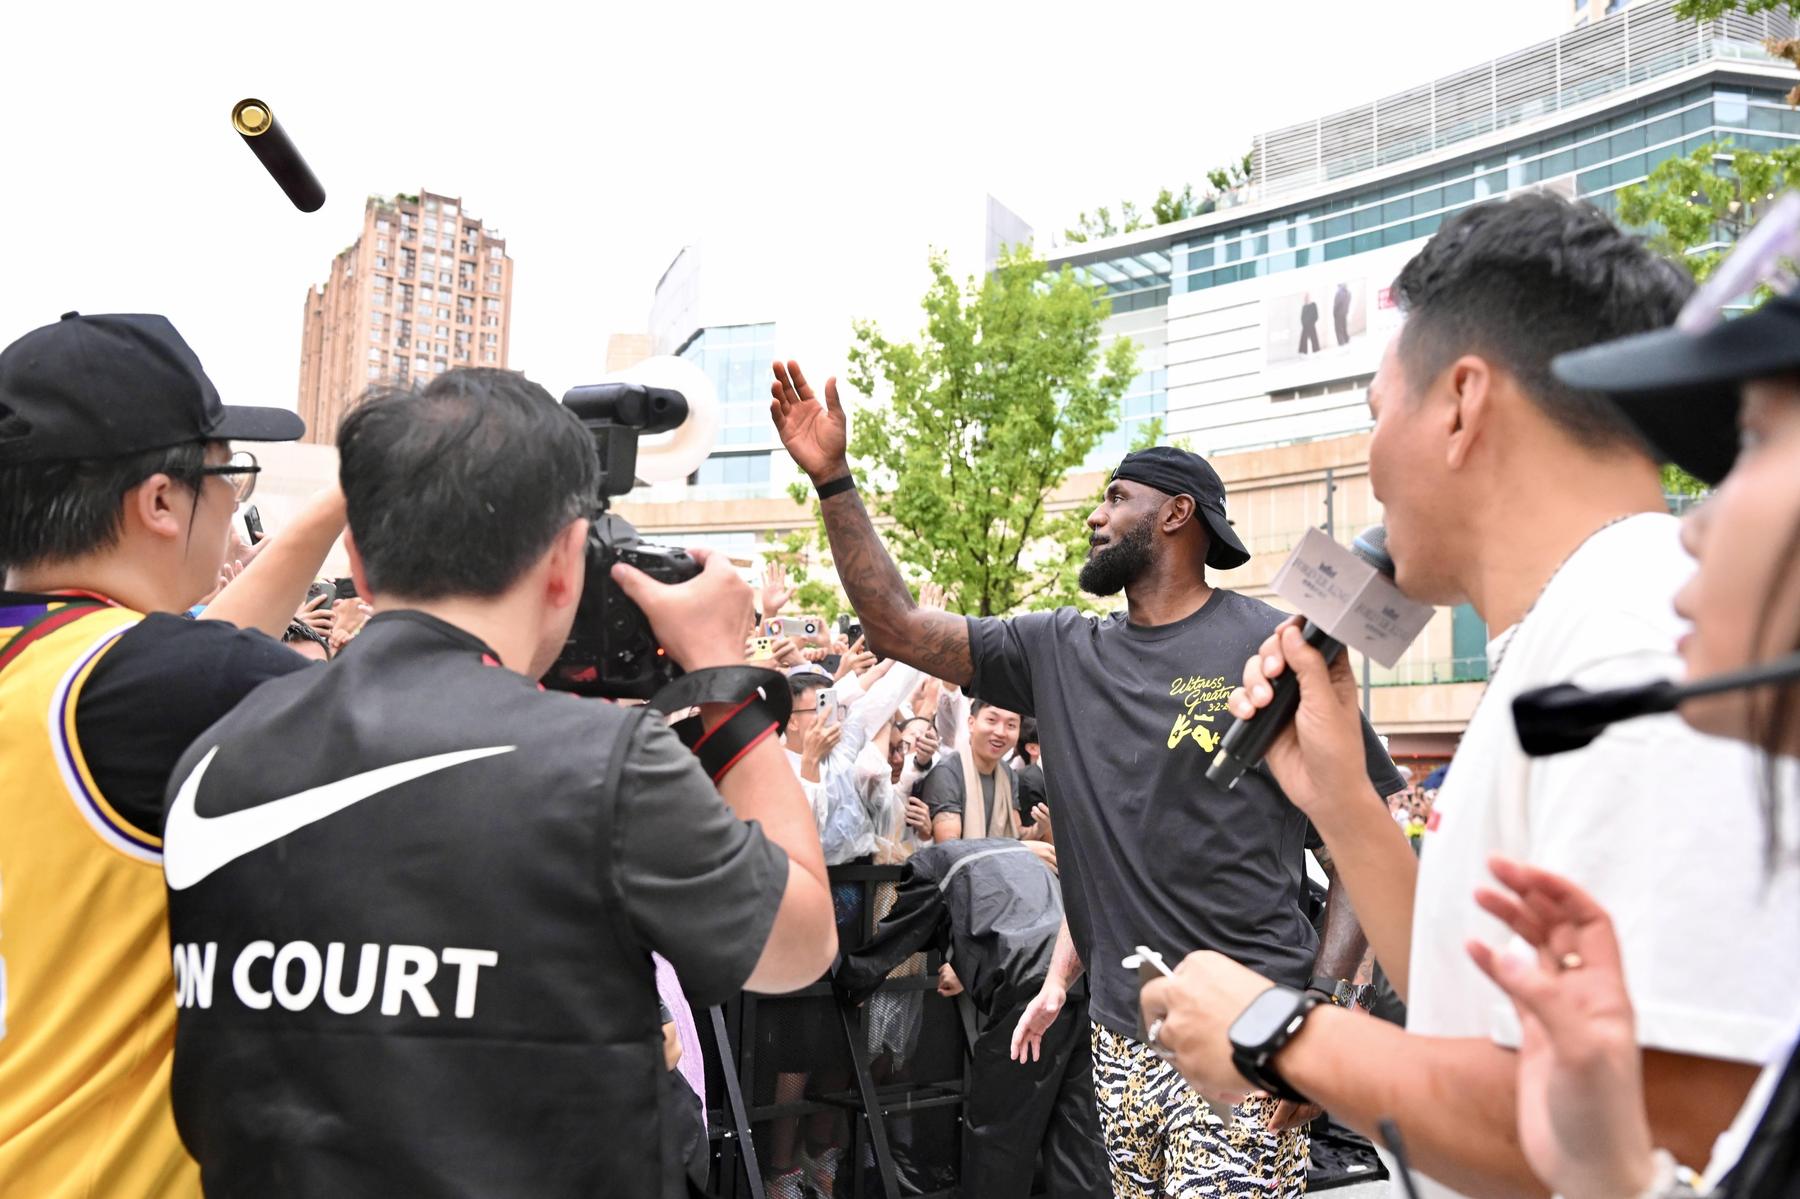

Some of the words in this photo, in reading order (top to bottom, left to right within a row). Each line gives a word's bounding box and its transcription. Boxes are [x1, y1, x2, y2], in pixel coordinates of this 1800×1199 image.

[1169, 676, 1224, 696] Witness
[1184, 686, 1235, 715] Greatn
[173, 942, 218, 1009] ON
[232, 940, 498, 1018] COURT
